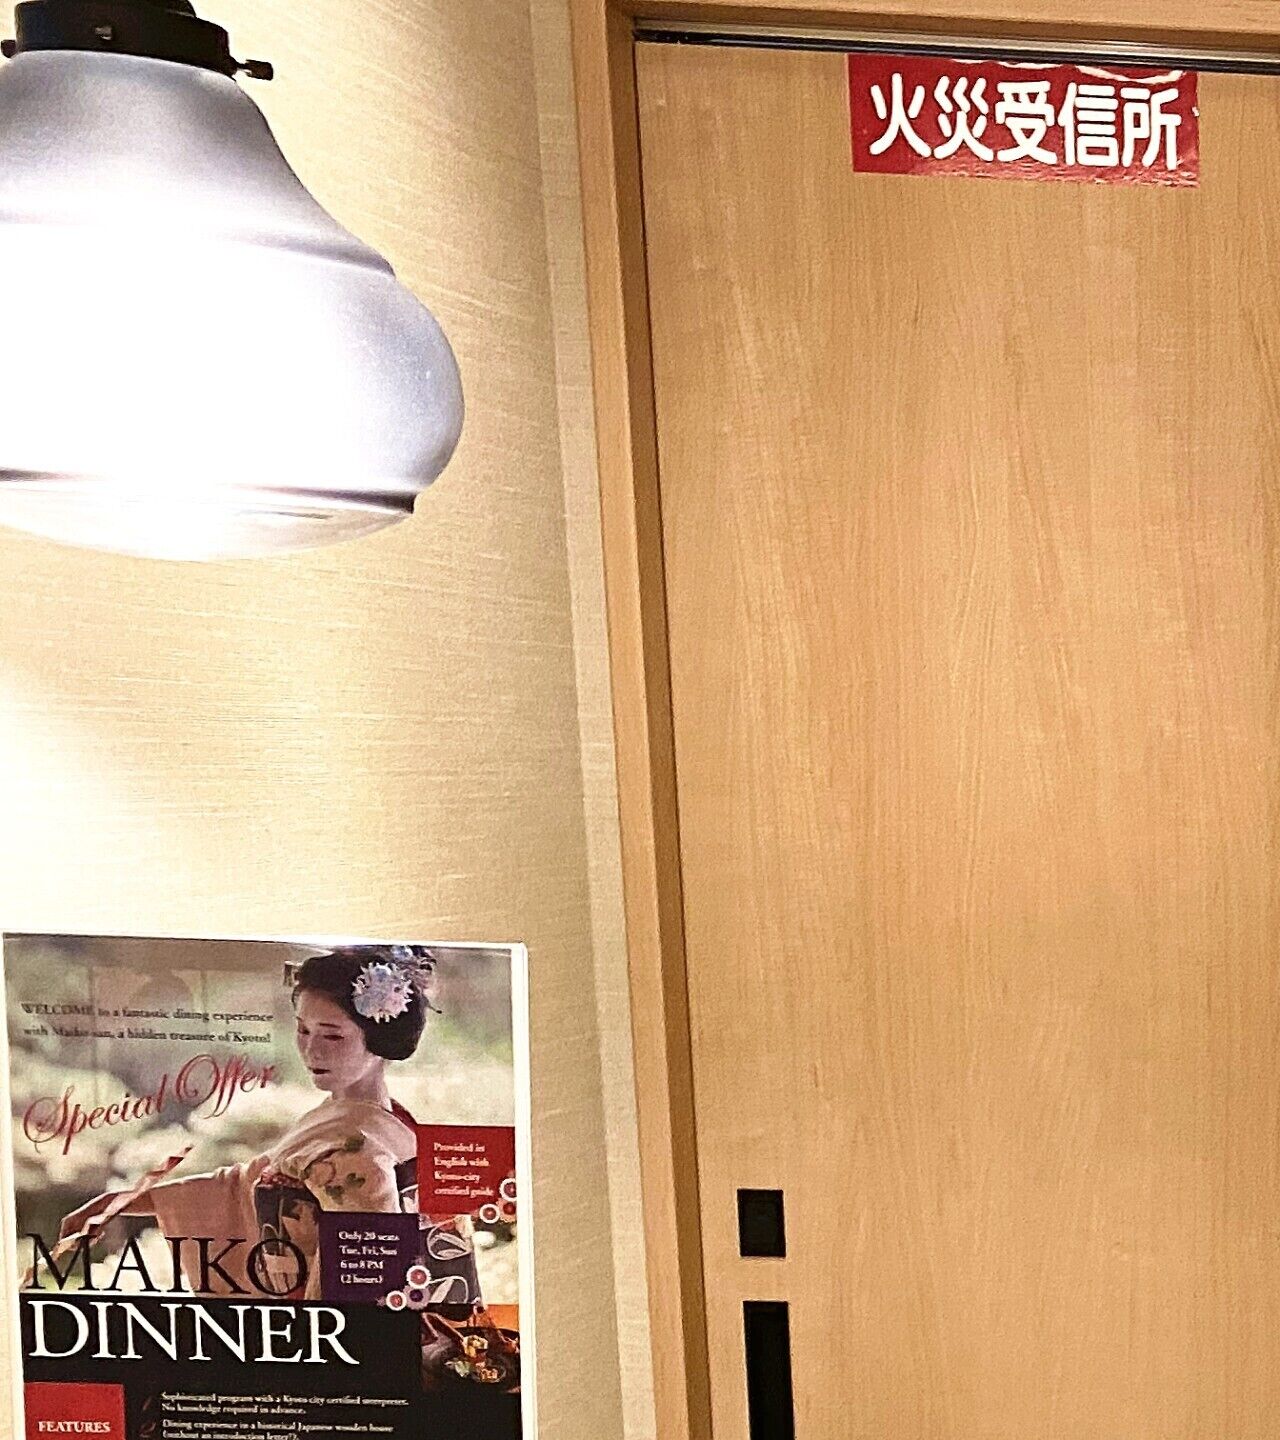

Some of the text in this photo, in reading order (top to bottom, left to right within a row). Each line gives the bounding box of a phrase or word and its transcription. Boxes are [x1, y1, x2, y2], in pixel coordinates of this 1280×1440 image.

[869, 72, 1182, 171] 火災受信所
[21, 1002, 94, 1016] WELCOME
[98, 1007, 110, 1016] to
[122, 1008, 169, 1019] fantastic
[172, 1009, 210, 1022] dining
[213, 1011, 273, 1024] experience
[23, 1027, 48, 1037] with
[128, 1029, 167, 1041] hidden
[170, 1031, 215, 1042] treasure
[217, 1031, 234, 1043] of
[23, 1053, 276, 1155] Special Offer
[434, 1142, 486, 1153] Provided in
[434, 1157, 490, 1169] English with
[434, 1185, 495, 1199] certified guide
[339, 1231, 401, 1242] Only 20 seats
[380, 1247, 398, 1257] Sun
[26, 1233, 308, 1296] MAIKO
[348, 1262, 359, 1270] to
[366, 1261, 384, 1270] PM
[28, 1301, 360, 1365] DINNER
[38, 1420, 111, 1434] FEATURES
